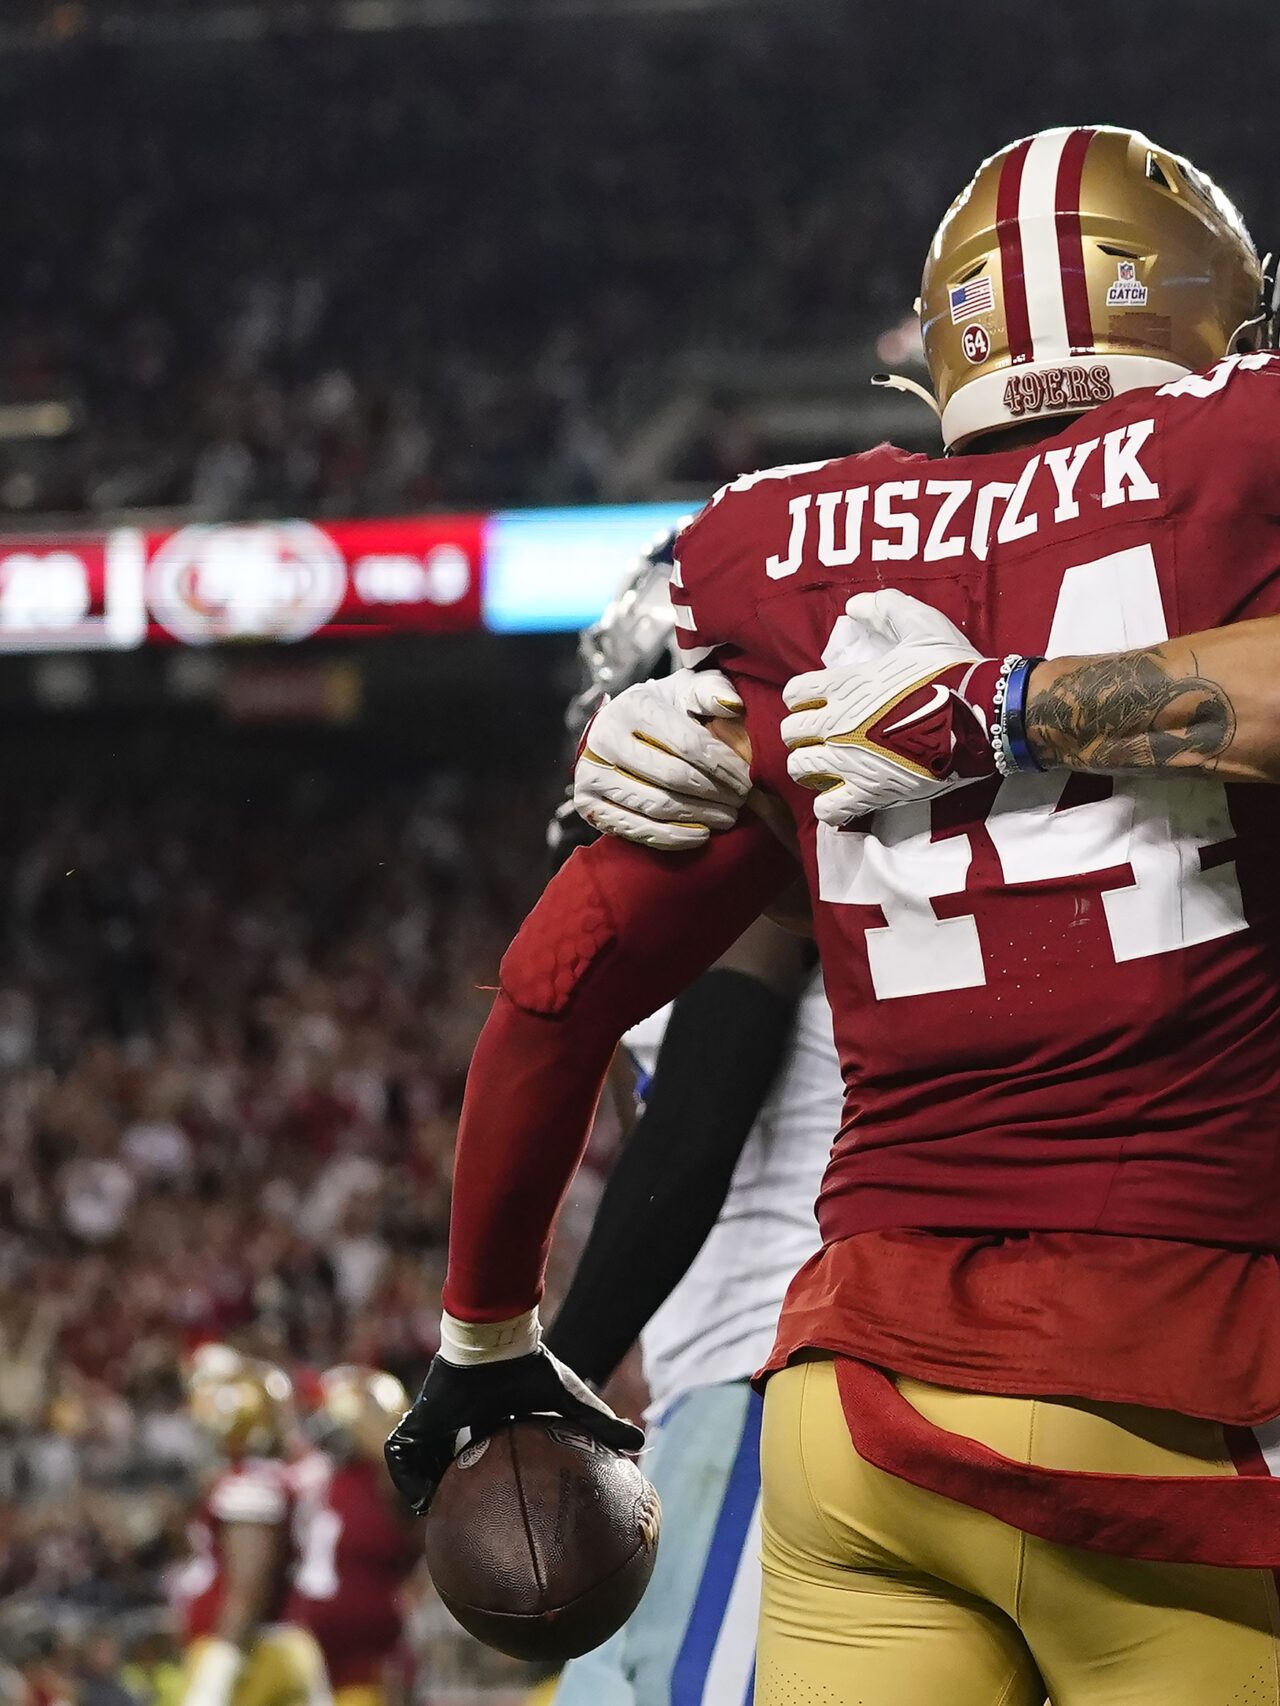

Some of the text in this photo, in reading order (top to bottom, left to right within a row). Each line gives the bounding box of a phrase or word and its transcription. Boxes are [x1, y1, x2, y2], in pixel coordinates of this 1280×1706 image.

[1109, 288, 1147, 300] CATCH
[964, 329, 987, 358] 64
[1003, 365, 1114, 417] 49ERS
